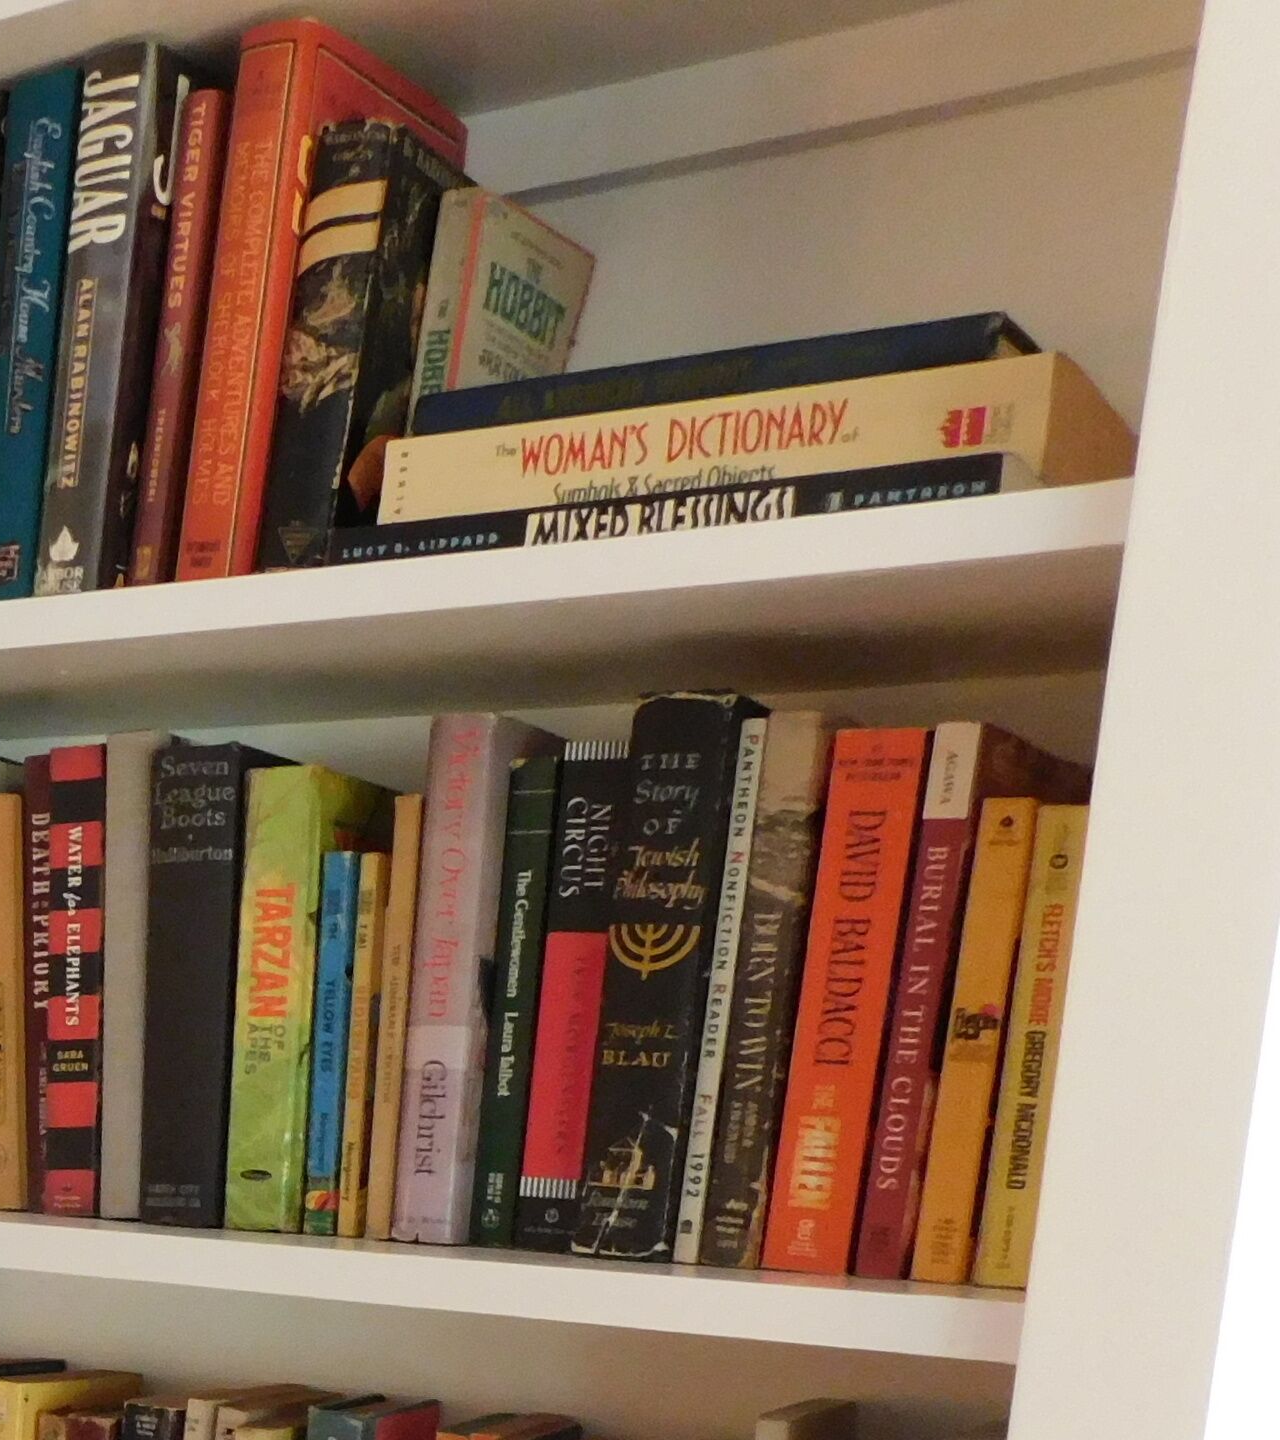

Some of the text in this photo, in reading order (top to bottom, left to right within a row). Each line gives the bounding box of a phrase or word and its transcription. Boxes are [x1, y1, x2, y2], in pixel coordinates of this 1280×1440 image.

[68, 70, 141, 255] JAGUAR
[166, 101, 207, 309] TIGER VIRTUES
[482, 261, 567, 350] HOBBIT
[57, 278, 95, 490] ALAN RABINOWITZ
[495, 398, 859, 478] The WOMAN'S DICTIONARY of
[154, 780, 237, 805] League
[159, 754, 230, 779] Seven
[159, 807, 227, 832] Boots
[559, 796, 589, 899] CIRCUS
[583, 804, 613, 889] NIGHT
[839, 809, 888, 903] DAVID
[61, 824, 84, 1028] WATER for ELEPHANTS
[250, 883, 298, 1020] TARZAN
[685, 733, 761, 1199] PANTHEON NONFICTION READER FALL 1992
[271, 1026, 286, 1053] OF
[812, 916, 872, 1067] BALDACCI
[875, 845, 950, 1191] BURIAL IN THE CLOUDS
[244, 1022, 260, 1076] APES
[257, 1024, 272, 1065] THE
[414, 1059, 448, 1178] Gilchrist
